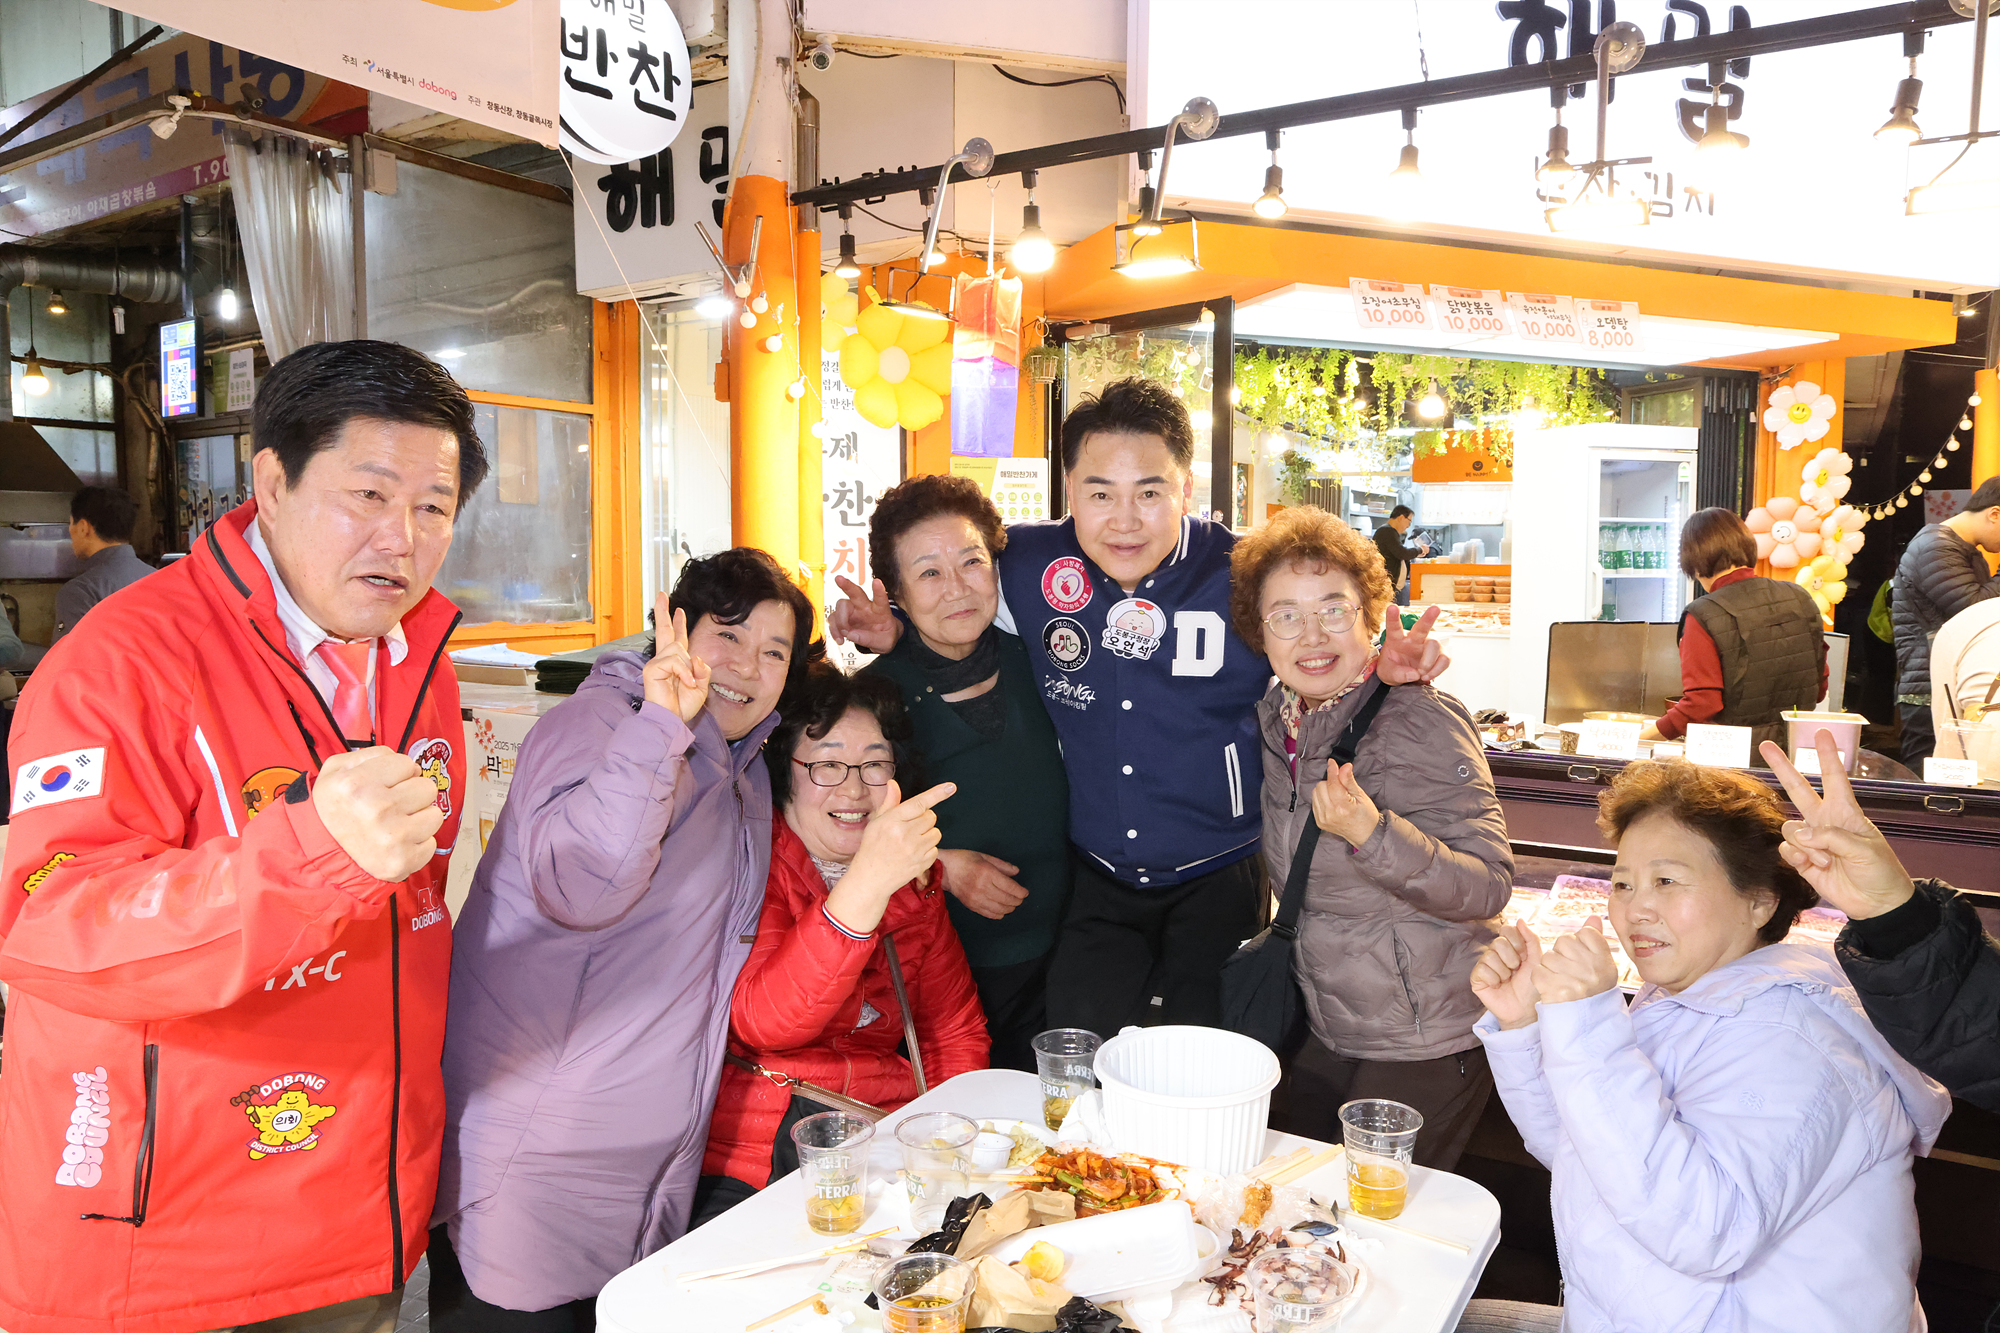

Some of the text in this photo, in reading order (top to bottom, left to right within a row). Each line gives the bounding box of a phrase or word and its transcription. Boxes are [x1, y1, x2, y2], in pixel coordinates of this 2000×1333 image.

[561, 17, 682, 121] 반찬
[342, 54, 358, 67] 주최
[377, 66, 415, 86] 서울특별시
[418, 78, 457, 101] dobong
[467, 95, 481, 107] 주관
[516, 110, 553, 129] 창동골목시장
[87, 181, 157, 216] 야채곱창볶음
[1361, 295, 1422, 310] 오징어초무침
[1446, 300, 1494, 316] 닭발볶음
[1363, 307, 1426, 326] 10,000
[1443, 315, 1504, 333] 10,000
[1596, 317, 1629, 331] 오뎅탕
[1521, 320, 1576, 339] 10,000
[1588, 329, 1634, 349] 8,000
[823, 431, 859, 464] 제
[823, 480, 874, 527] 찬
[1055, 620, 1075, 630] SEOUL
[1107, 636, 1150, 657] 오언석
[1114, 629, 1150, 645] 도봉구청장
[1172, 611, 1226, 677] D
[1047, 649, 1086, 669] DOBONG SOCKS
[494, 740, 509, 751] 2025
[260, 1073, 326, 1097] DOBONG
[1041, 1082, 1068, 1099] ERRA
[275, 1114, 298, 1125] 의회
[250, 1133, 319, 1154] DISTRICT COUNCIL
[815, 1182, 859, 1200] TERRA
